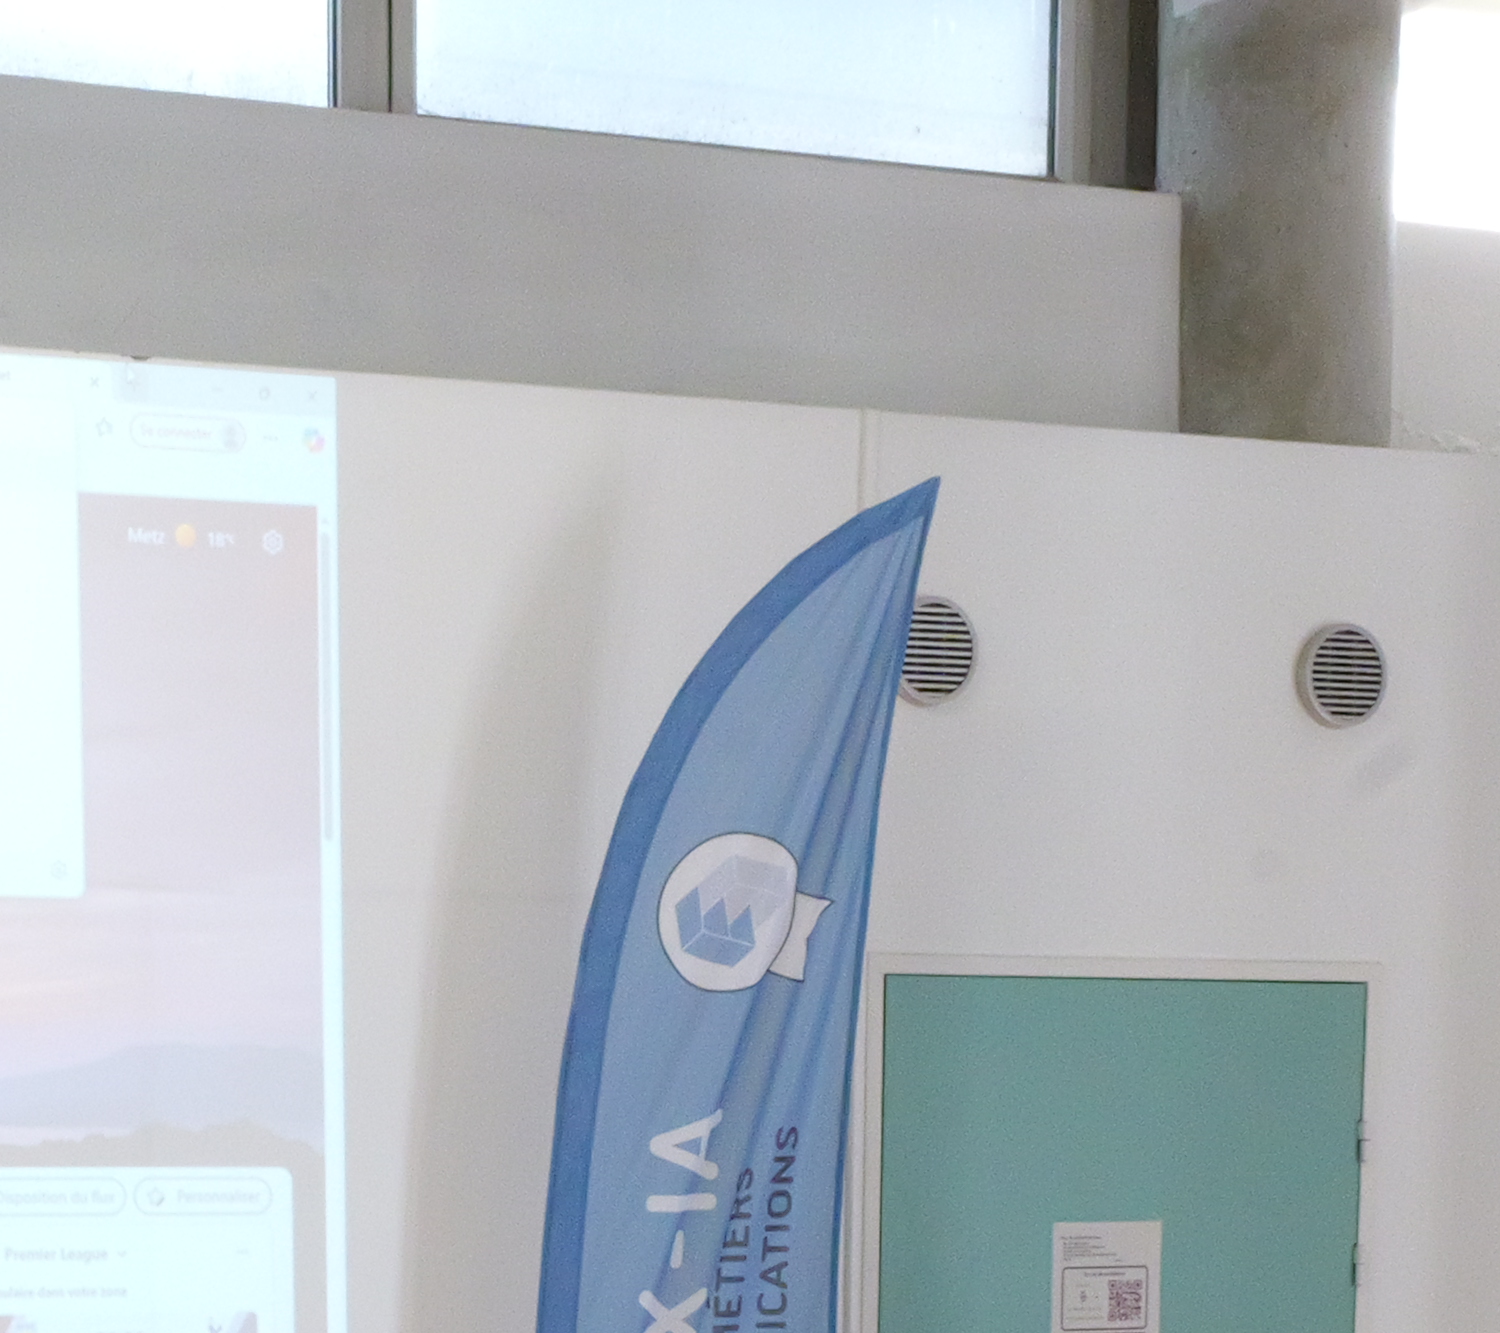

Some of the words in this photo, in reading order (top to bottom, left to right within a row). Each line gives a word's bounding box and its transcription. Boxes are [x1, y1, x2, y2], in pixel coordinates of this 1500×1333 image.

[127, 527, 166, 546] Metz
[70, 1190, 89, 1204] du
[91, 1190, 115, 1204] flux
[176, 1189, 260, 1204] Personnaliser
[4, 1247, 57, 1262] Premier
[60, 1247, 108, 1265] League
